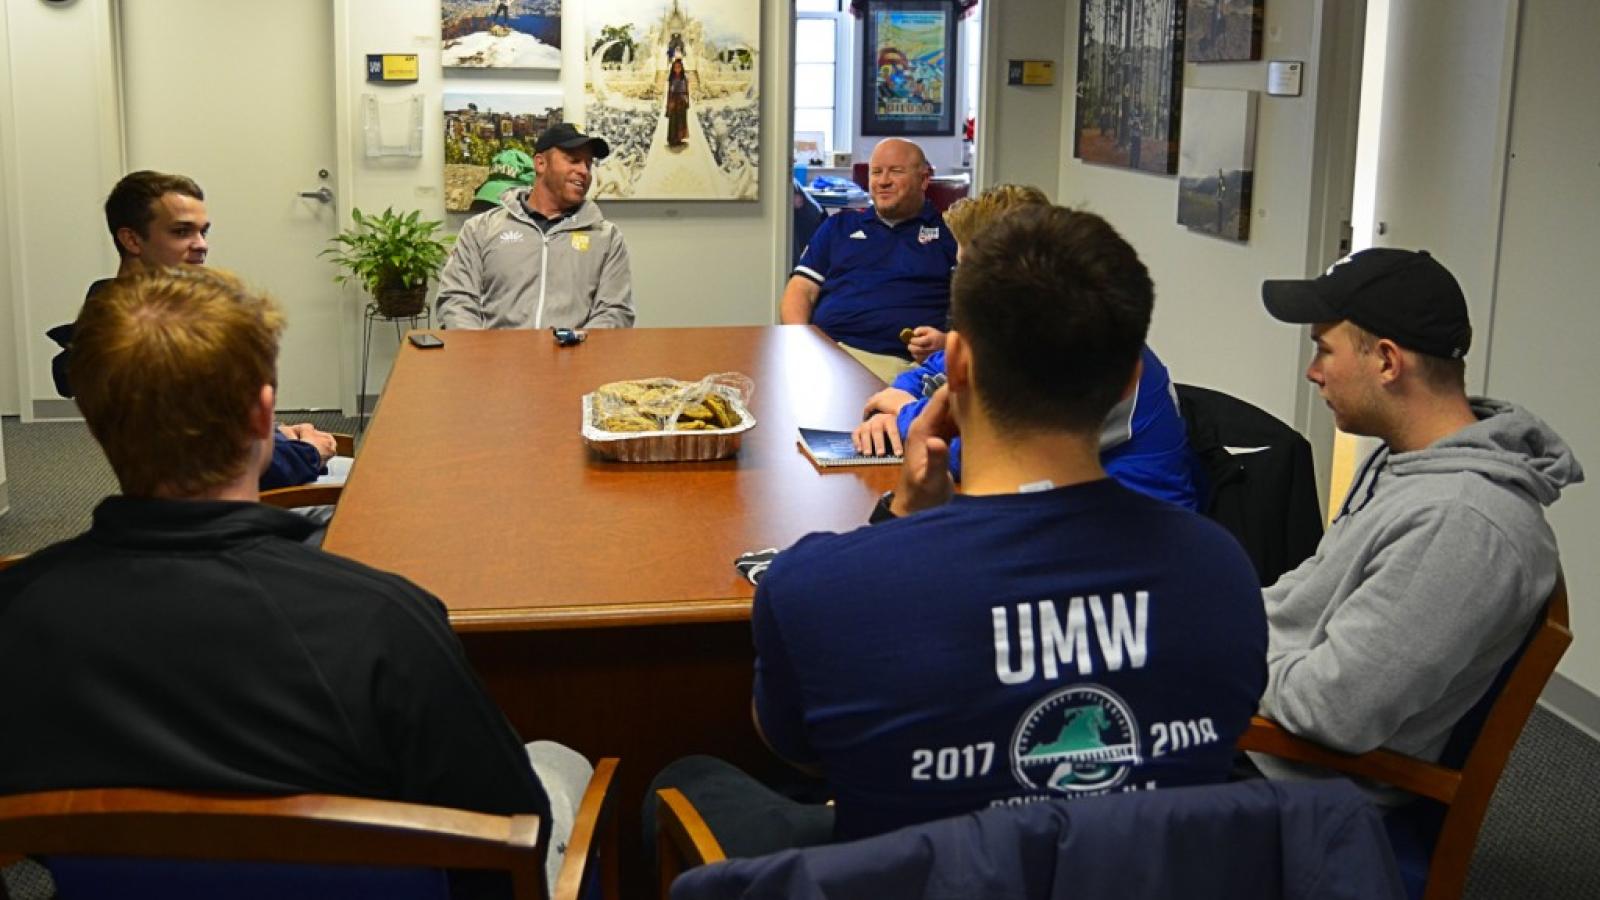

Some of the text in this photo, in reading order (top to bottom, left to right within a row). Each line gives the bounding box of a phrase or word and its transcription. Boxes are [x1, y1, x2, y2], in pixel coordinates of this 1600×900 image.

[992, 591, 1149, 684] UMW
[1150, 717, 1218, 757] 2018
[911, 742, 995, 780] 2017
